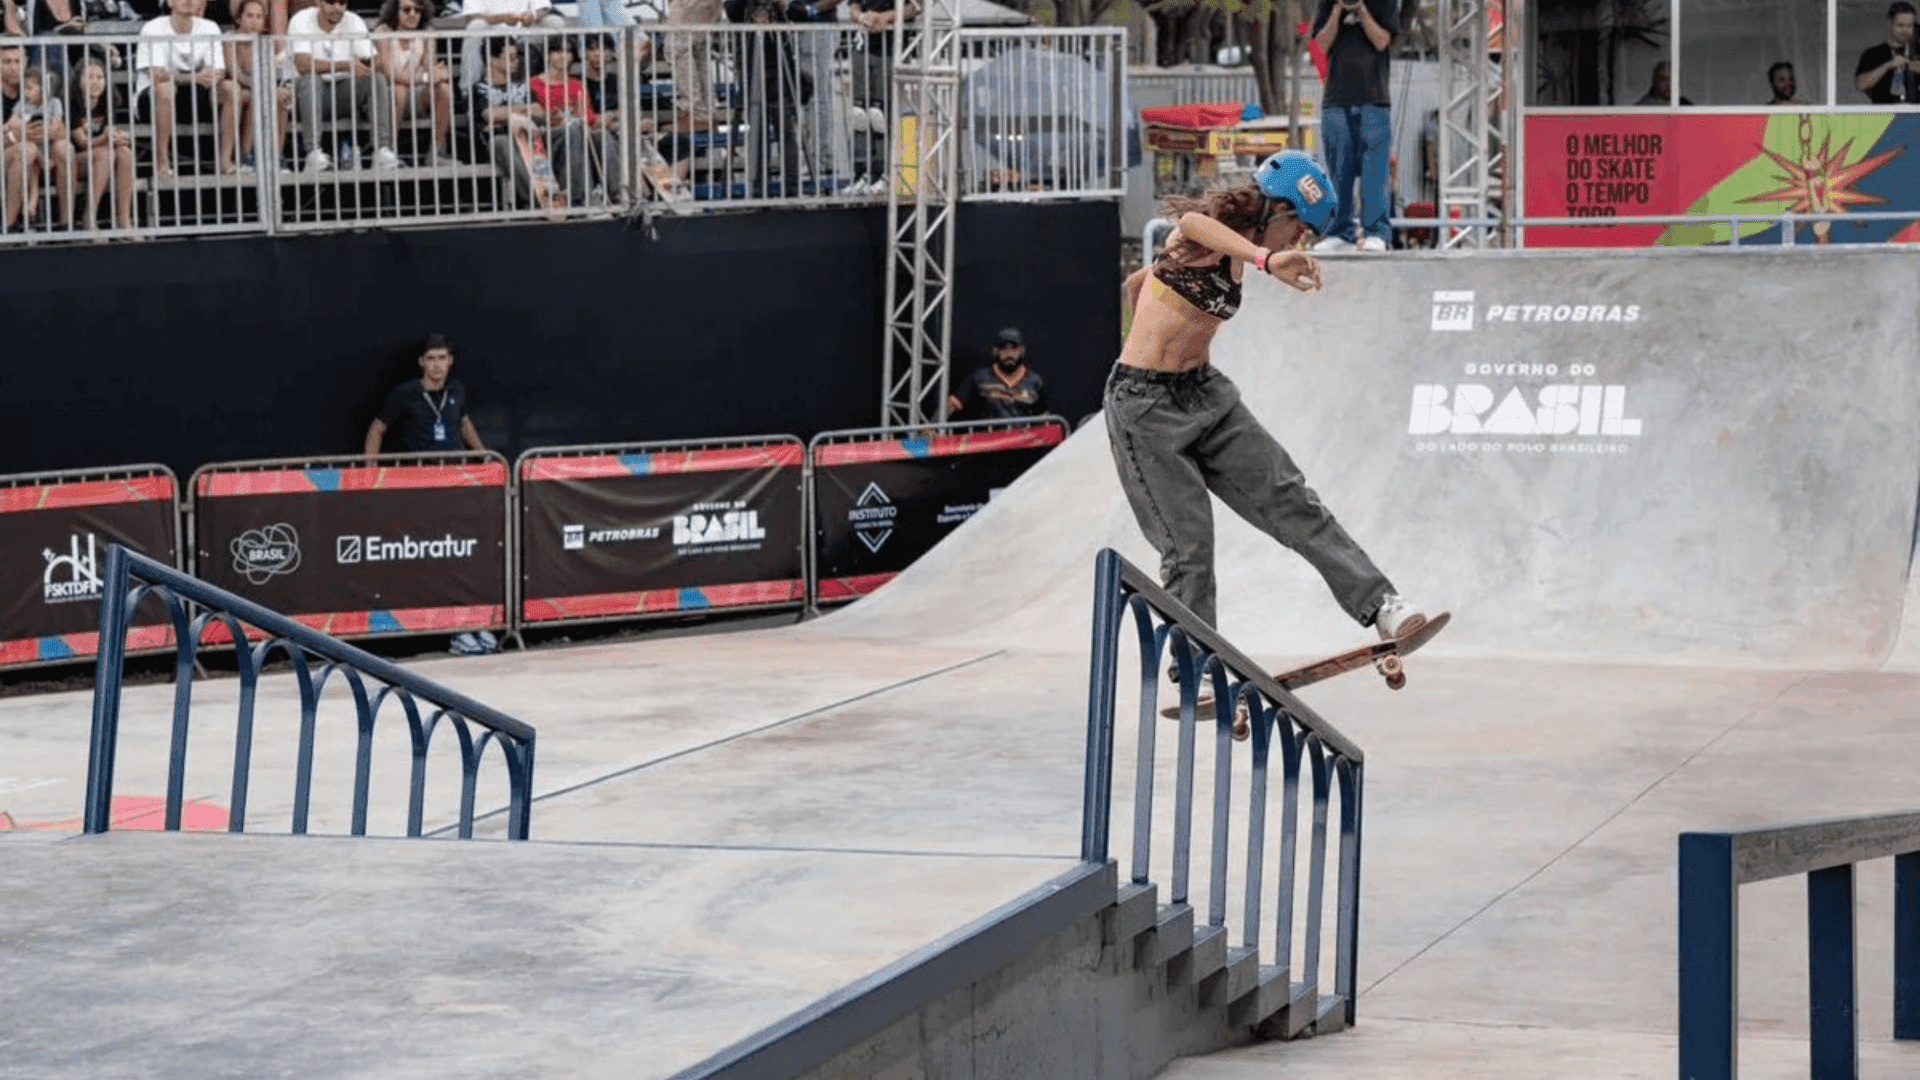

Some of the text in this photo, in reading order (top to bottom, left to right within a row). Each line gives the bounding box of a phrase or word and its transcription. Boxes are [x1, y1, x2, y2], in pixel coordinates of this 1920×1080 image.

[1566, 134, 1662, 155] O MELHOR
[1567, 158, 1656, 180] DO SKATE
[1566, 182, 1649, 204] O TEMPO
[1485, 304, 1641, 322] PETROBRAS
[1464, 363, 1596, 376] GOVERNO DO
[1407, 383, 1642, 436] BRASIL
[848, 505, 898, 522] INSTITUTO
[588, 527, 660, 543] PETROBRAS
[673, 509, 766, 545] BRASIL
[249, 548, 286, 562] BRASIL
[366, 534, 477, 561] Embratur
